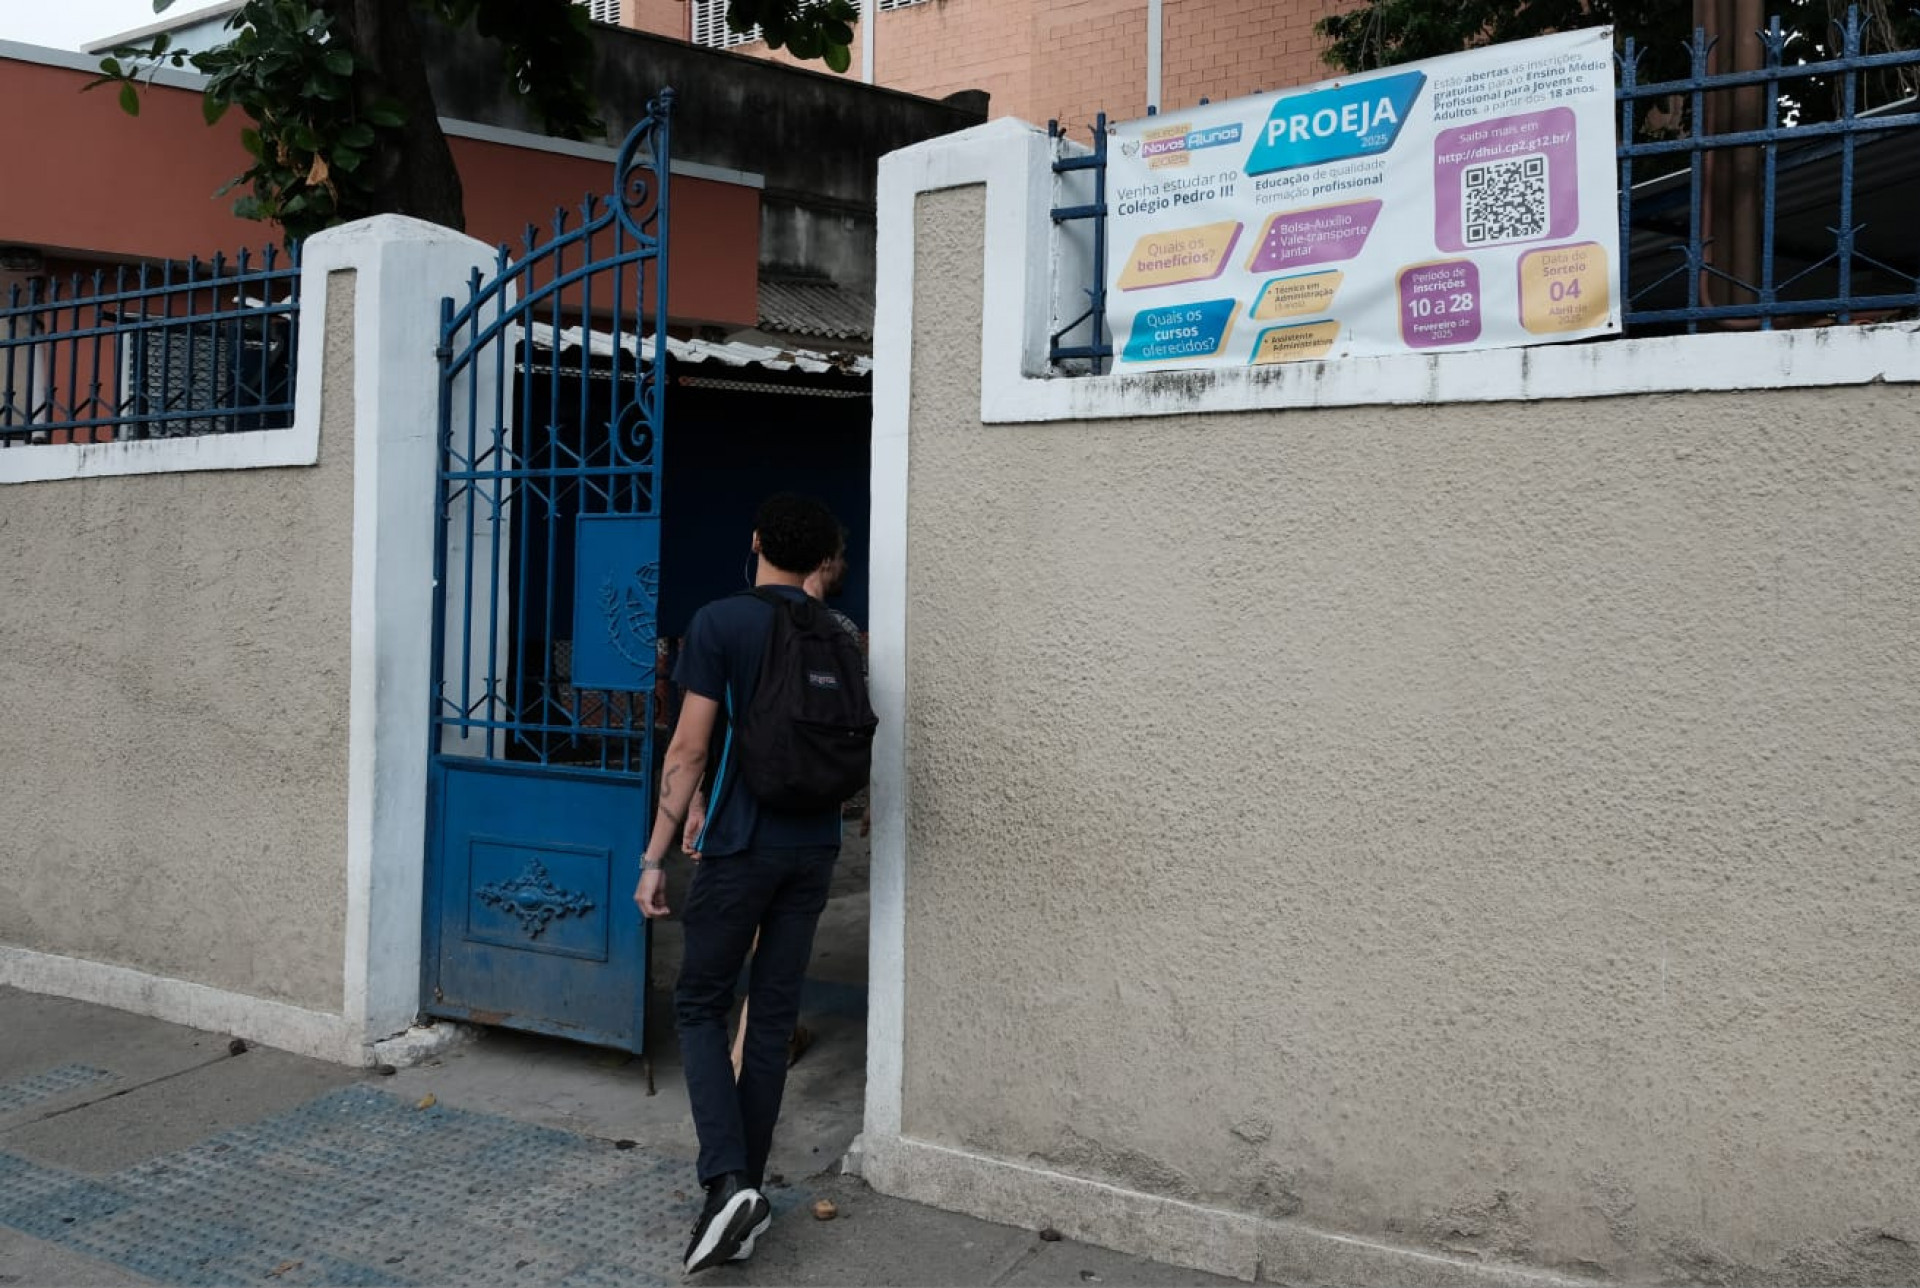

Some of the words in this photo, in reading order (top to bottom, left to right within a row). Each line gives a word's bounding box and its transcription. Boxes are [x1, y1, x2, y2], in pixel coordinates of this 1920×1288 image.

[1434, 83, 1485, 101] gratuitas
[1488, 78, 1513, 91] para
[1516, 76, 1523, 84] o
[1526, 66, 1566, 81] Ensino
[1568, 61, 1606, 73] Médio
[1465, 68, 1510, 82] abertas
[1512, 64, 1524, 74] as
[1434, 92, 1500, 112] Profissional
[1504, 86, 1530, 99] para
[1533, 77, 1572, 92] Jovens
[1576, 75, 1583, 83] e
[1484, 104, 1490, 112] a
[1492, 98, 1520, 112] partir
[1550, 90, 1562, 99] 18
[1268, 98, 1398, 146] PROEJA
[1460, 130, 1488, 143] Saiba
[1492, 126, 1518, 137] mais
[1520, 122, 1539, 132] em
[1144, 140, 1185, 154] Novos
[1188, 128, 1240, 148] Alunos
[1360, 134, 1388, 148] 2025
[1256, 172, 1310, 190] Educação
[1312, 168, 1326, 180] de
[1329, 158, 1386, 178] qualidade
[1117, 184, 1159, 200] Venha
[1164, 174, 1215, 192] estudar
[1220, 170, 1238, 181] no
[1256, 186, 1310, 204] Formação
[1312, 174, 1383, 197] profissional
[1118, 197, 1169, 215] Colégio
[1174, 189, 1215, 206] Pedro
[1220, 184, 1234, 198] II!
[1148, 240, 1185, 257] Quais
[1188, 239, 1204, 250] os
[1281, 246, 1311, 260] Jantar
[1542, 255, 1568, 265] Data
[1572, 252, 1586, 260] do
[1137, 249, 1215, 272] benefícios?
[1544, 264, 1586, 277] Sorteio
[1453, 268, 1466, 276] de
[1550, 278, 1582, 302] 04
[1408, 298, 1430, 318] 10
[1434, 300, 1446, 314] a
[1450, 293, 1473, 312] 28
[1148, 310, 1182, 326] Quais
[1186, 310, 1202, 320] os
[1414, 321, 1456, 333] Fevereiro
[1458, 318, 1470, 326] de
[1154, 326, 1198, 340] cursos
[1142, 338, 1214, 357] oferecidos?
